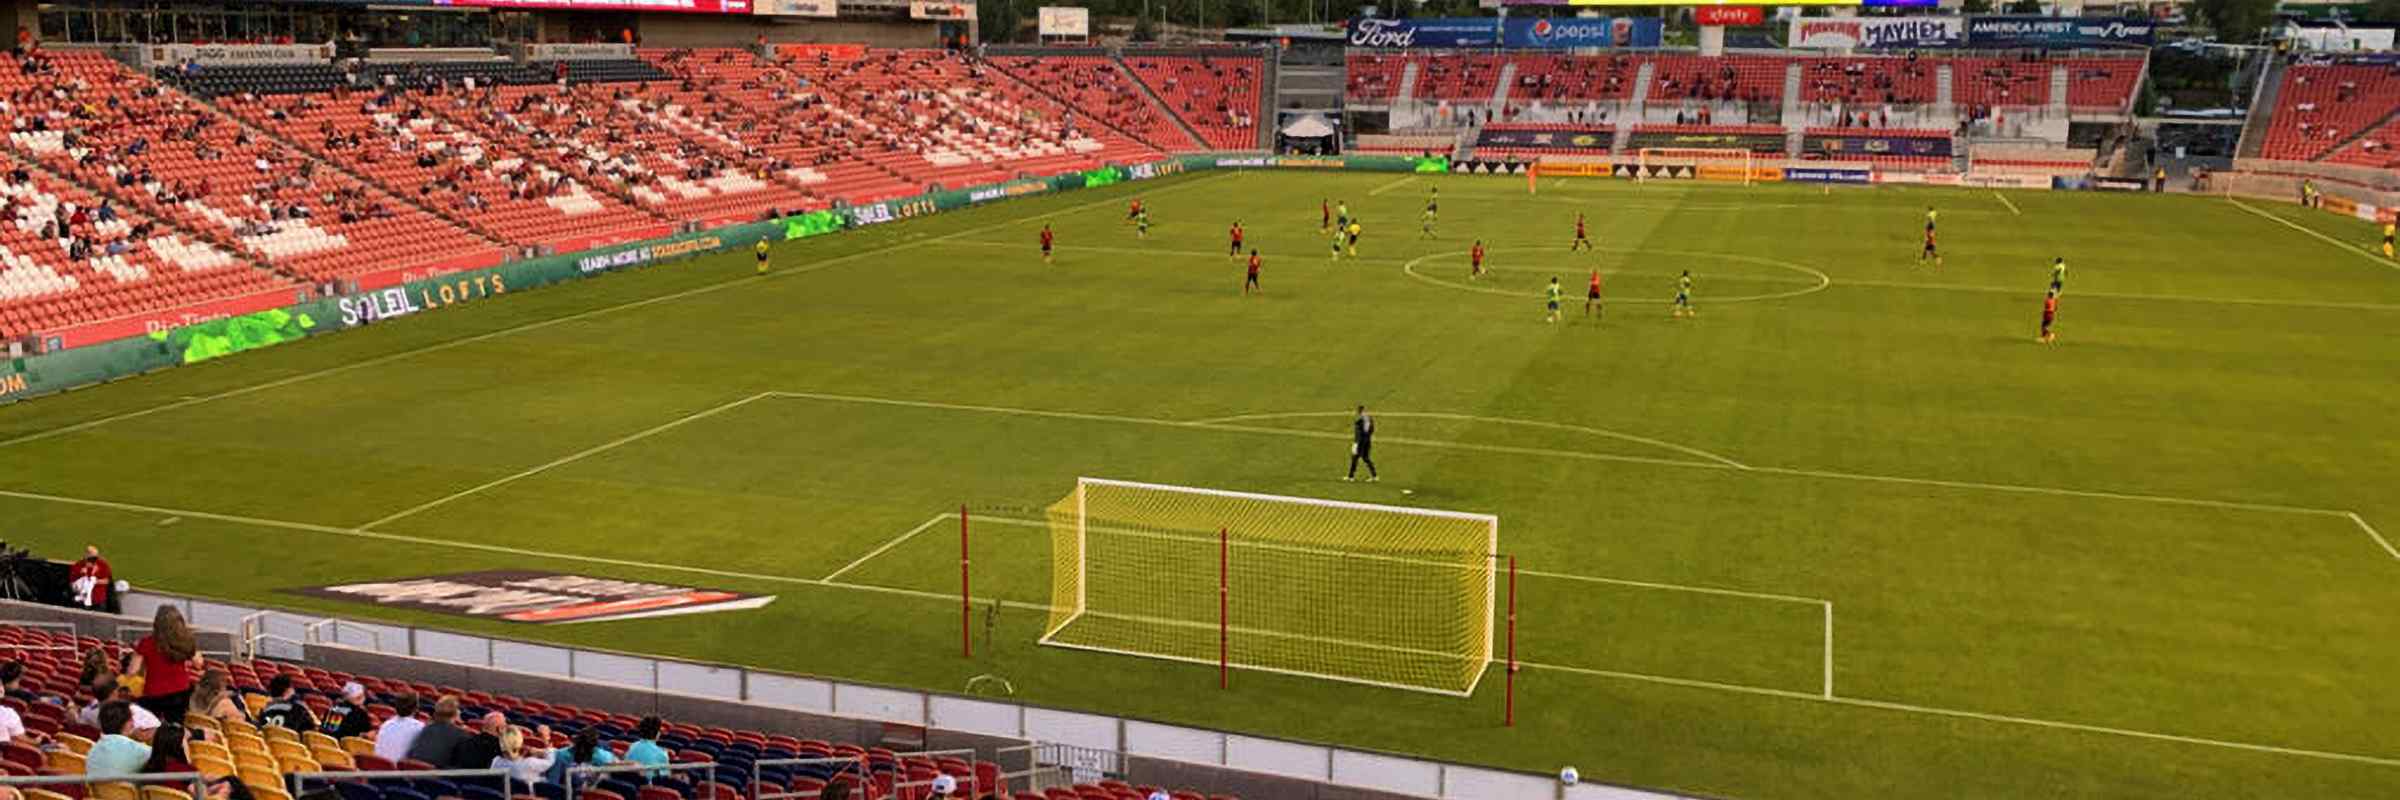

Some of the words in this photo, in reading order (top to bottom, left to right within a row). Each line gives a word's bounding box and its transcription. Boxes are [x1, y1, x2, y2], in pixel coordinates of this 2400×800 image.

[1351, 18, 1416, 47] Ford
[1555, 23, 1605, 41] pepsi
[1865, 20, 1946, 42] MAYHEM
[1972, 21, 2032, 33] AMERICA
[2033, 21, 2071, 33] FIRST
[339, 286, 420, 326] SOLEIL
[422, 272, 505, 309] LOFTS
